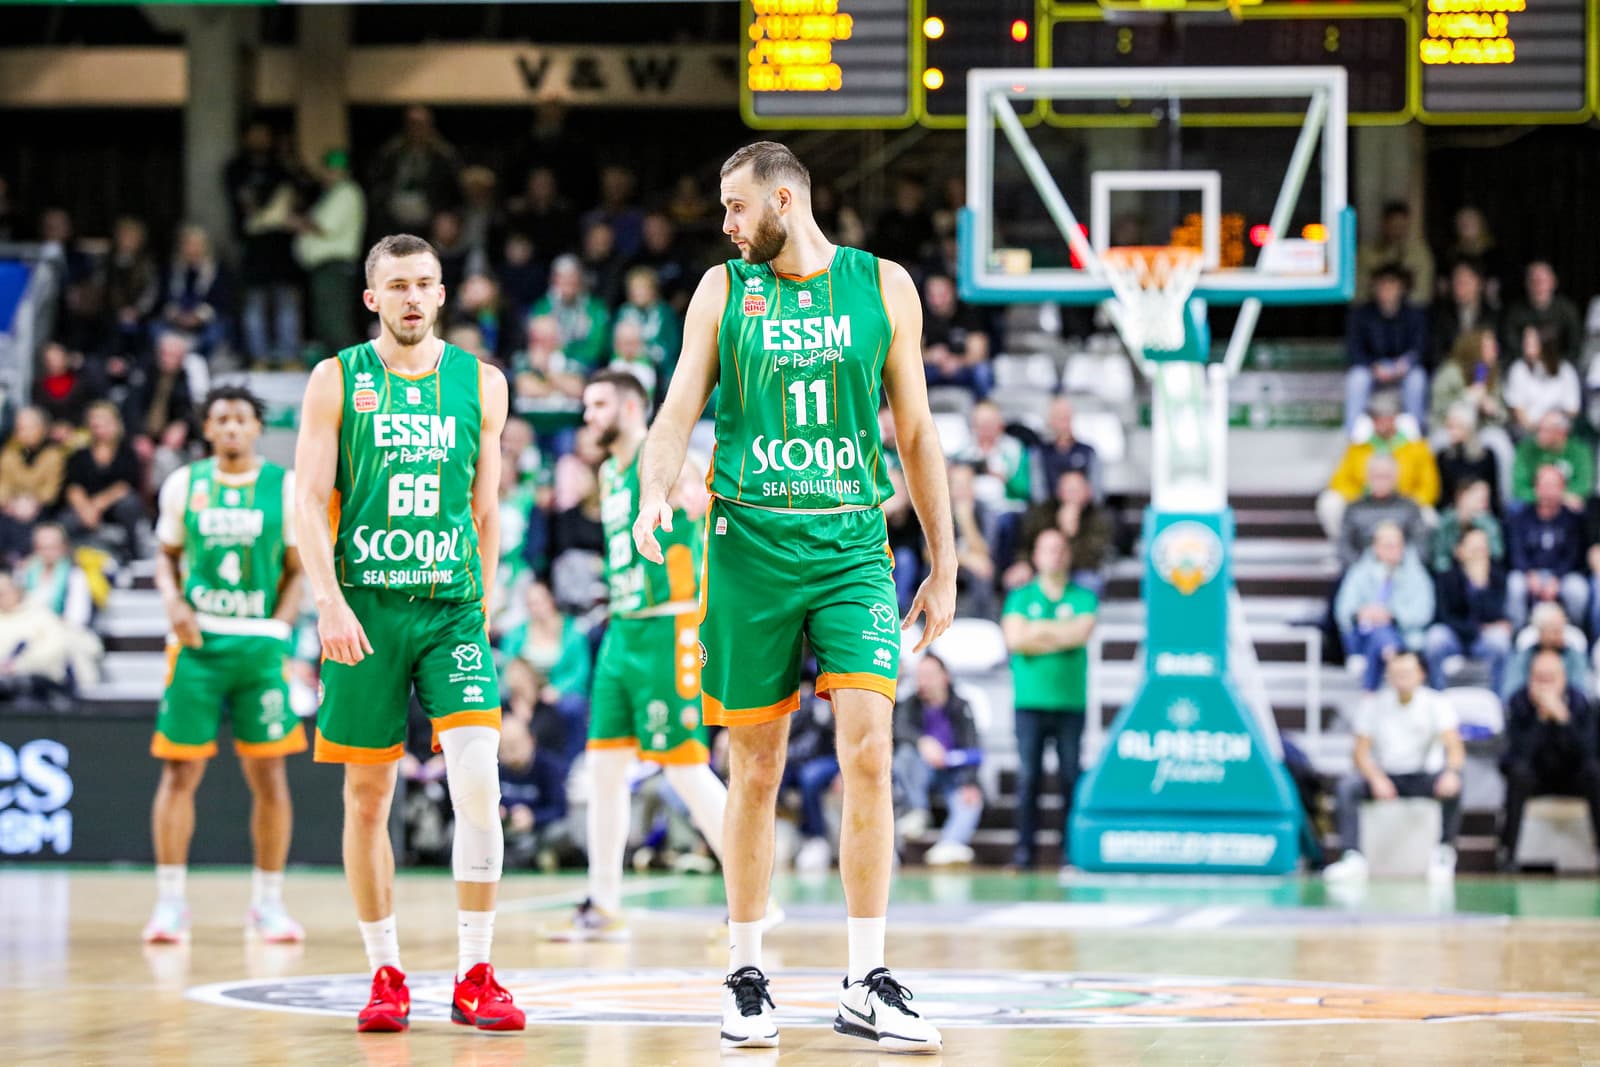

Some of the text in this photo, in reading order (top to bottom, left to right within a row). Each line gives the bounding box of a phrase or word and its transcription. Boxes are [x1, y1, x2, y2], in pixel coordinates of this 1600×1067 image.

[744, 304, 766, 312] KING
[762, 315, 852, 351] ESSM
[788, 379, 828, 426] 11
[373, 413, 456, 448] ESSM
[752, 431, 865, 477] Scogal
[388, 473, 440, 517] 66
[762, 480, 860, 496] SEA SOLUTIONS
[353, 525, 461, 569] Scogal
[217, 550, 242, 586] 4
[362, 569, 453, 585] SEA SOLUTIONS
